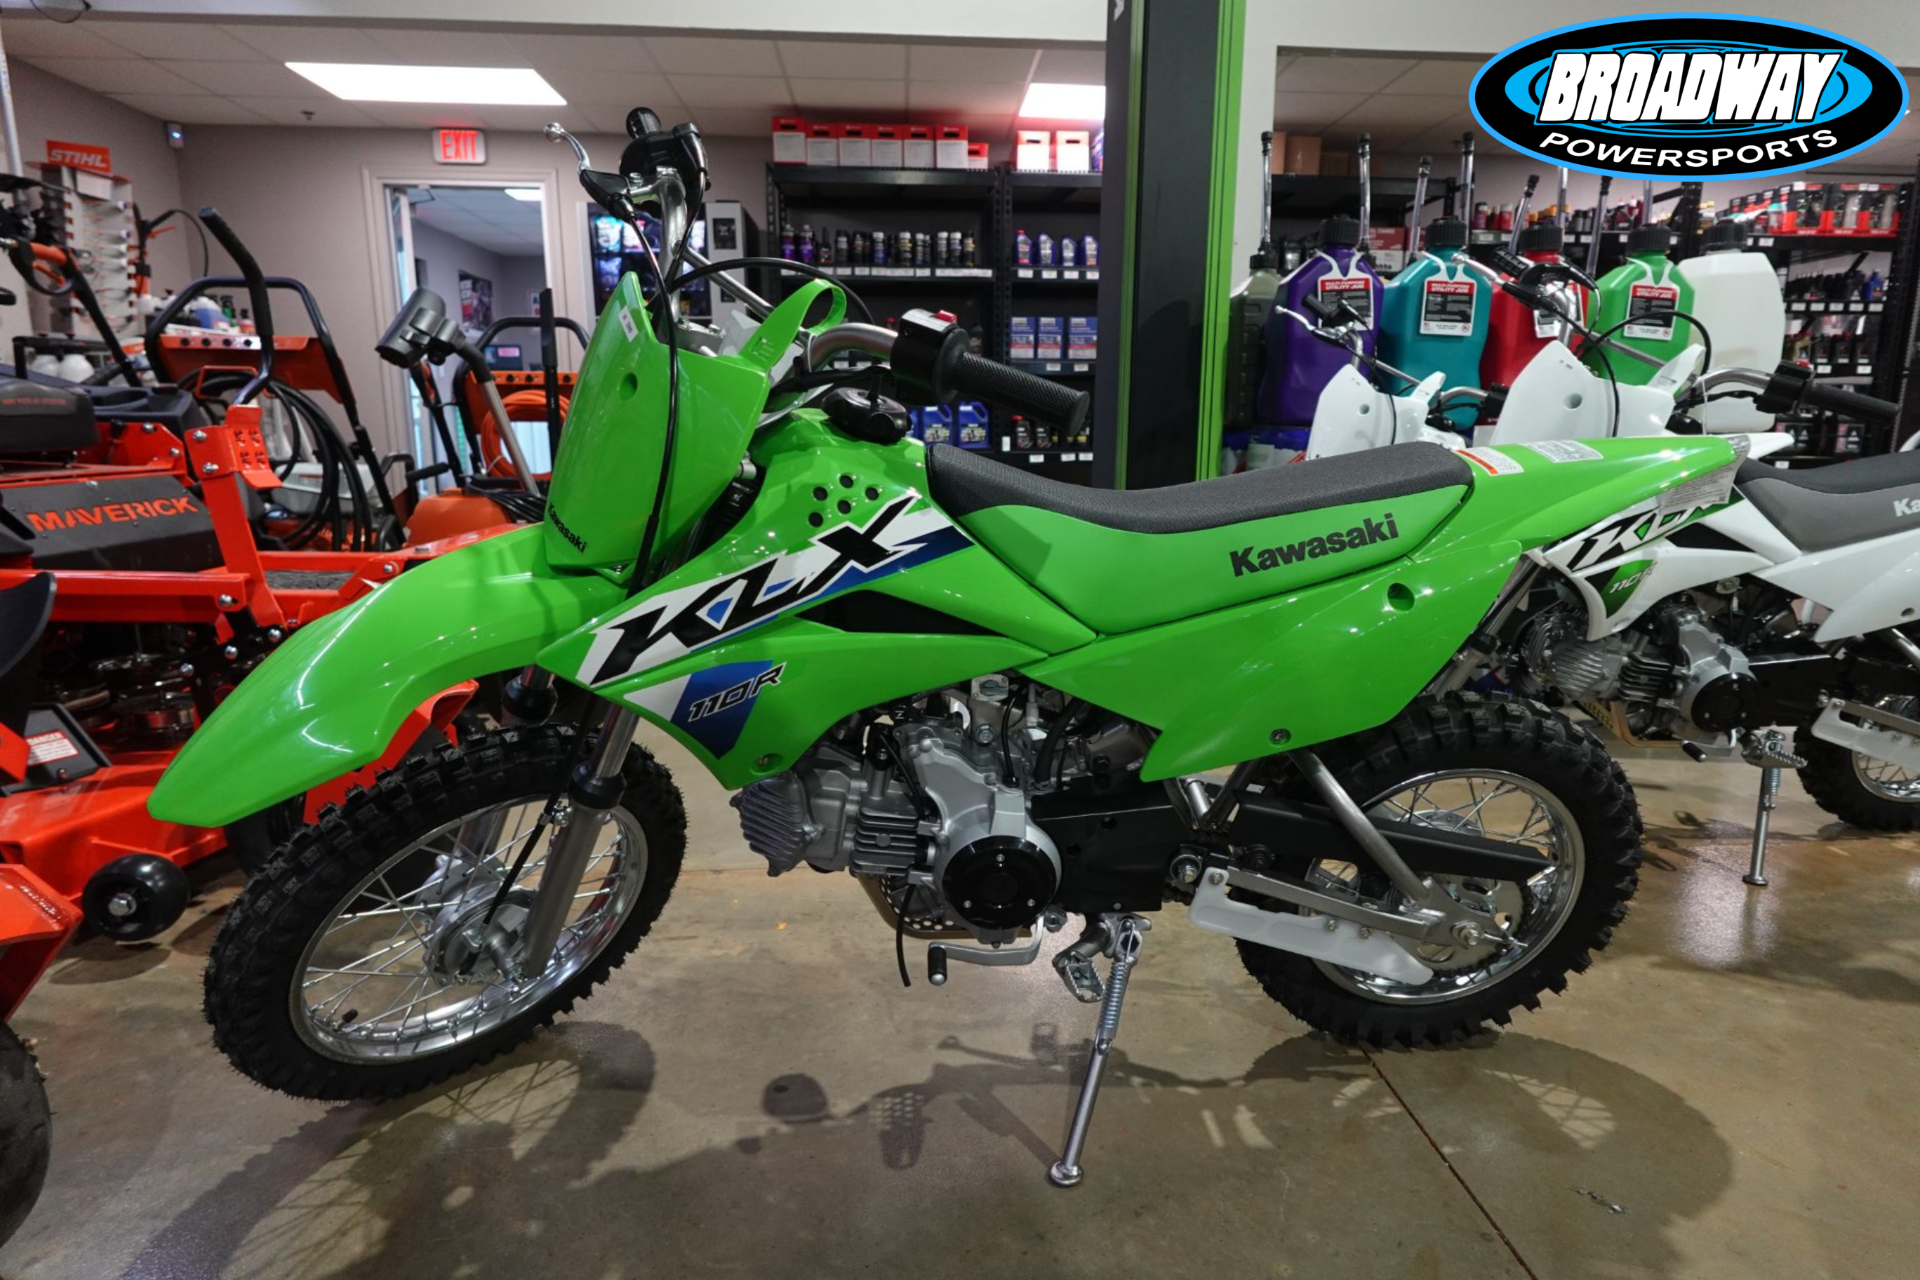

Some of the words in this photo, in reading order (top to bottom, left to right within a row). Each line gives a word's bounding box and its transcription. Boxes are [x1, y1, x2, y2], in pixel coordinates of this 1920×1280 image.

[49, 148, 107, 168] STIHL
[441, 130, 477, 160] EXIT
[26, 496, 199, 532] MAVERICK
[548, 502, 587, 554] Kawasaki
[1229, 512, 1399, 578] Kawasaki
[589, 494, 922, 687] KLX
[687, 661, 787, 724] 110R
